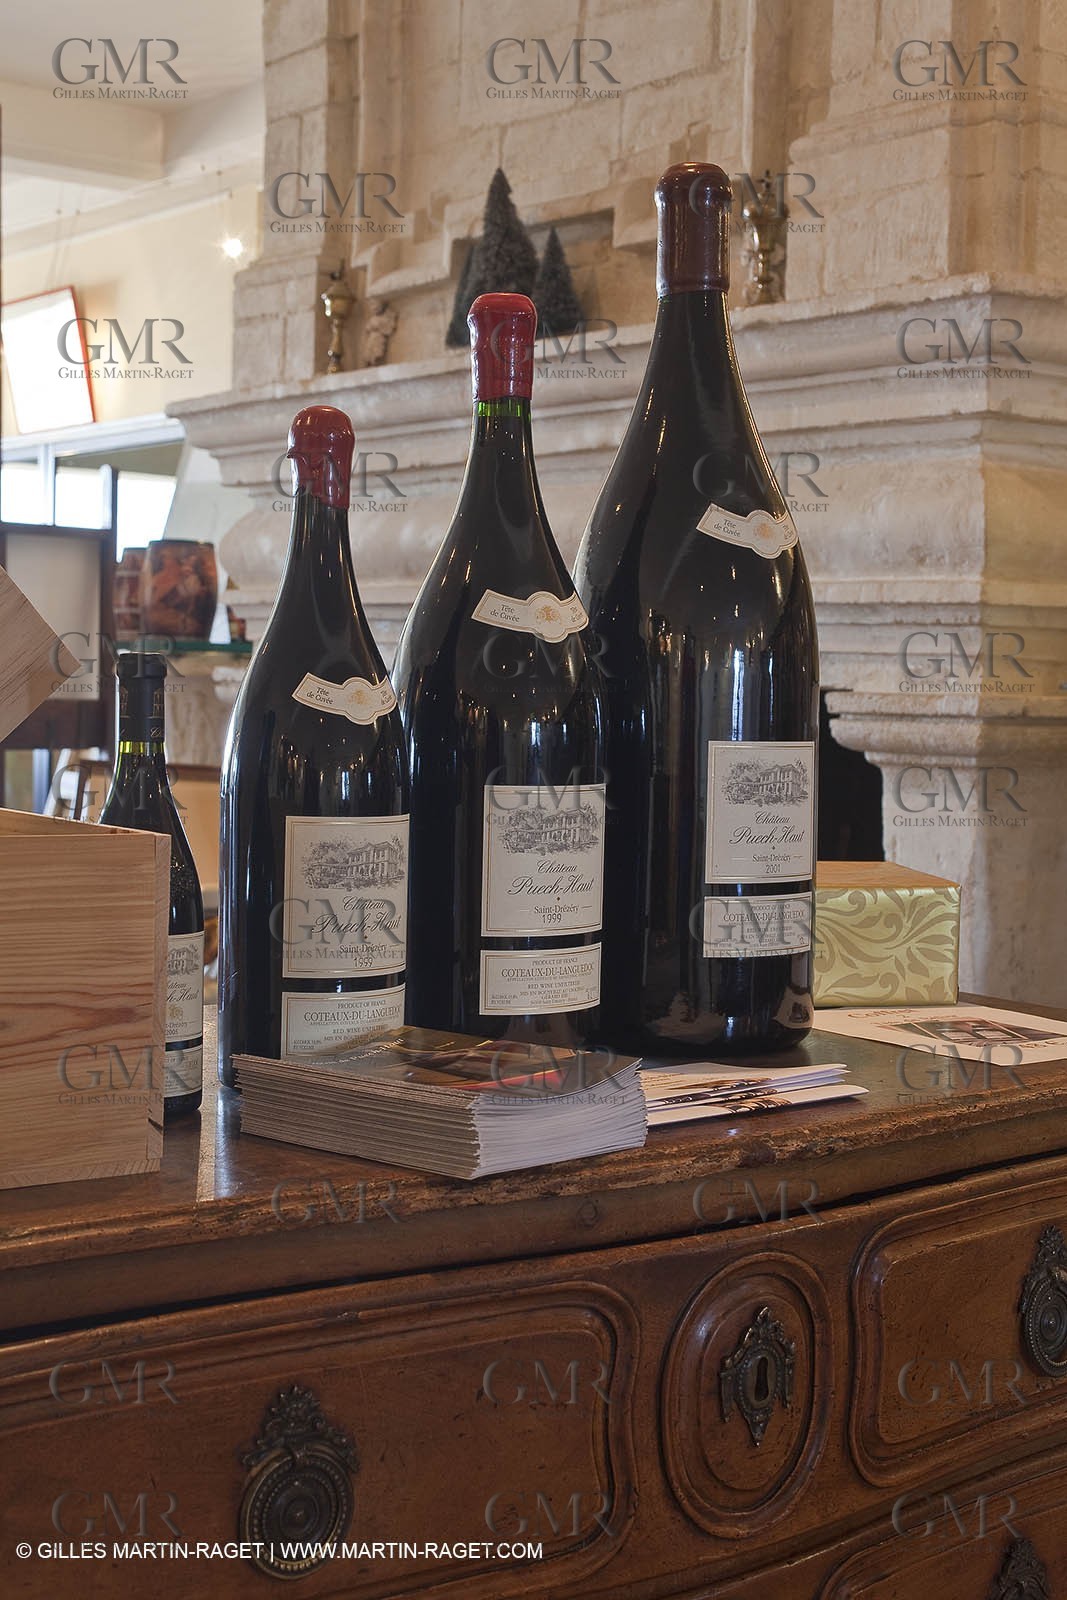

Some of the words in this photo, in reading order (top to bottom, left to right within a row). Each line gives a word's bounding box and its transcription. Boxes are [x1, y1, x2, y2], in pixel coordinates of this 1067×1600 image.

[490, 609, 499, 618] de
[755, 810, 790, 825] Château
[729, 825, 804, 844] Puech-Haut
[537, 860, 578, 874] Château
[508, 875, 594, 896] Puech-Haut
[312, 912, 402, 933] Puech-Haut
[542, 914, 562, 924] 1999
